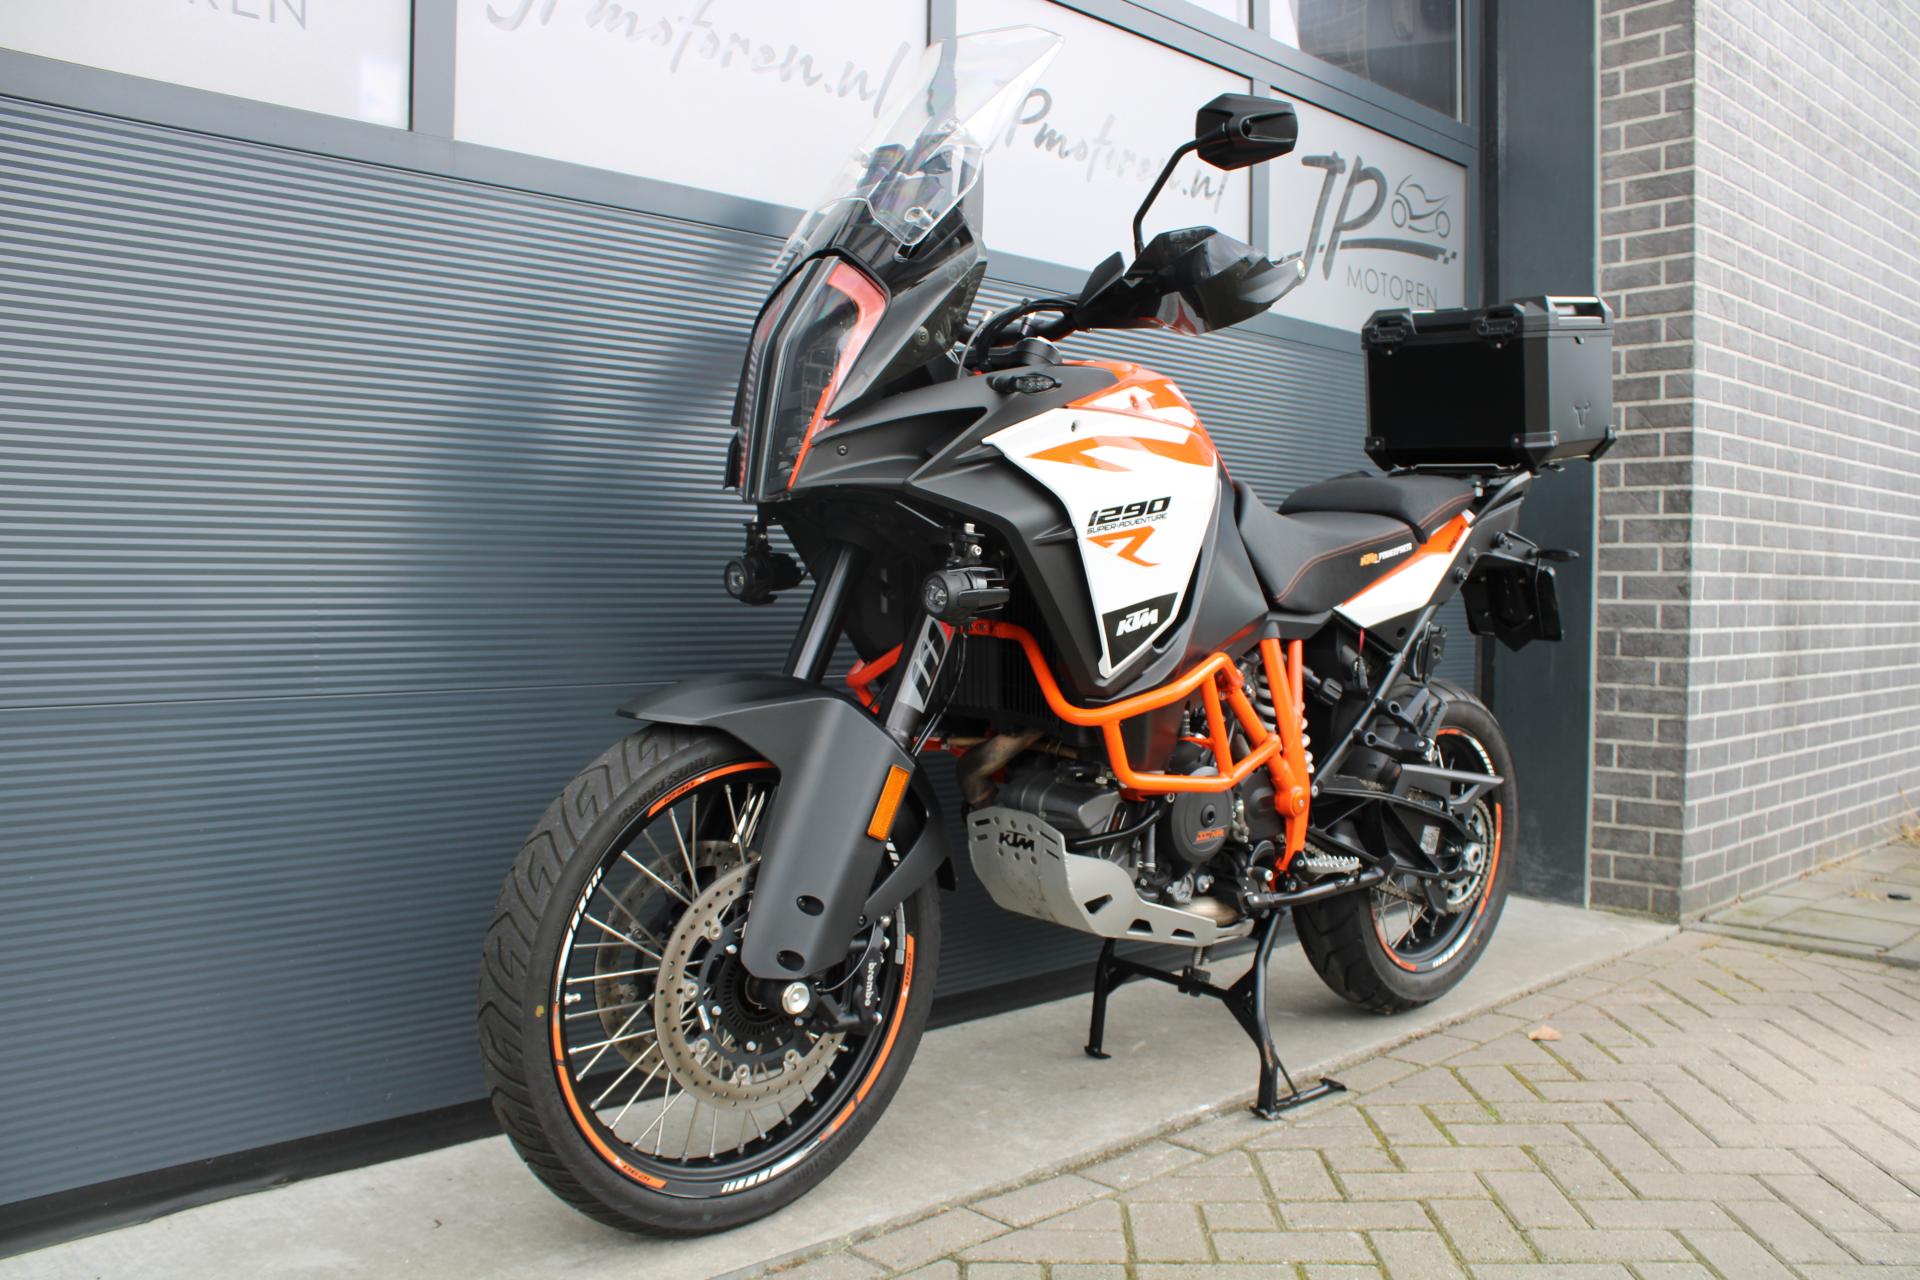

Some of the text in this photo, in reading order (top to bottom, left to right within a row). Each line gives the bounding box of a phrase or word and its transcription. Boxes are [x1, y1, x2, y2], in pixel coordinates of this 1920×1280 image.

[486, 0, 911, 118] motoren.nl
[1347, 265, 1438, 308] MOTOREN
[1088, 496, 1172, 526] 1290
[1116, 607, 1159, 637] KTM
[999, 830, 1035, 852] KTM
[864, 960, 878, 1007] brembo
